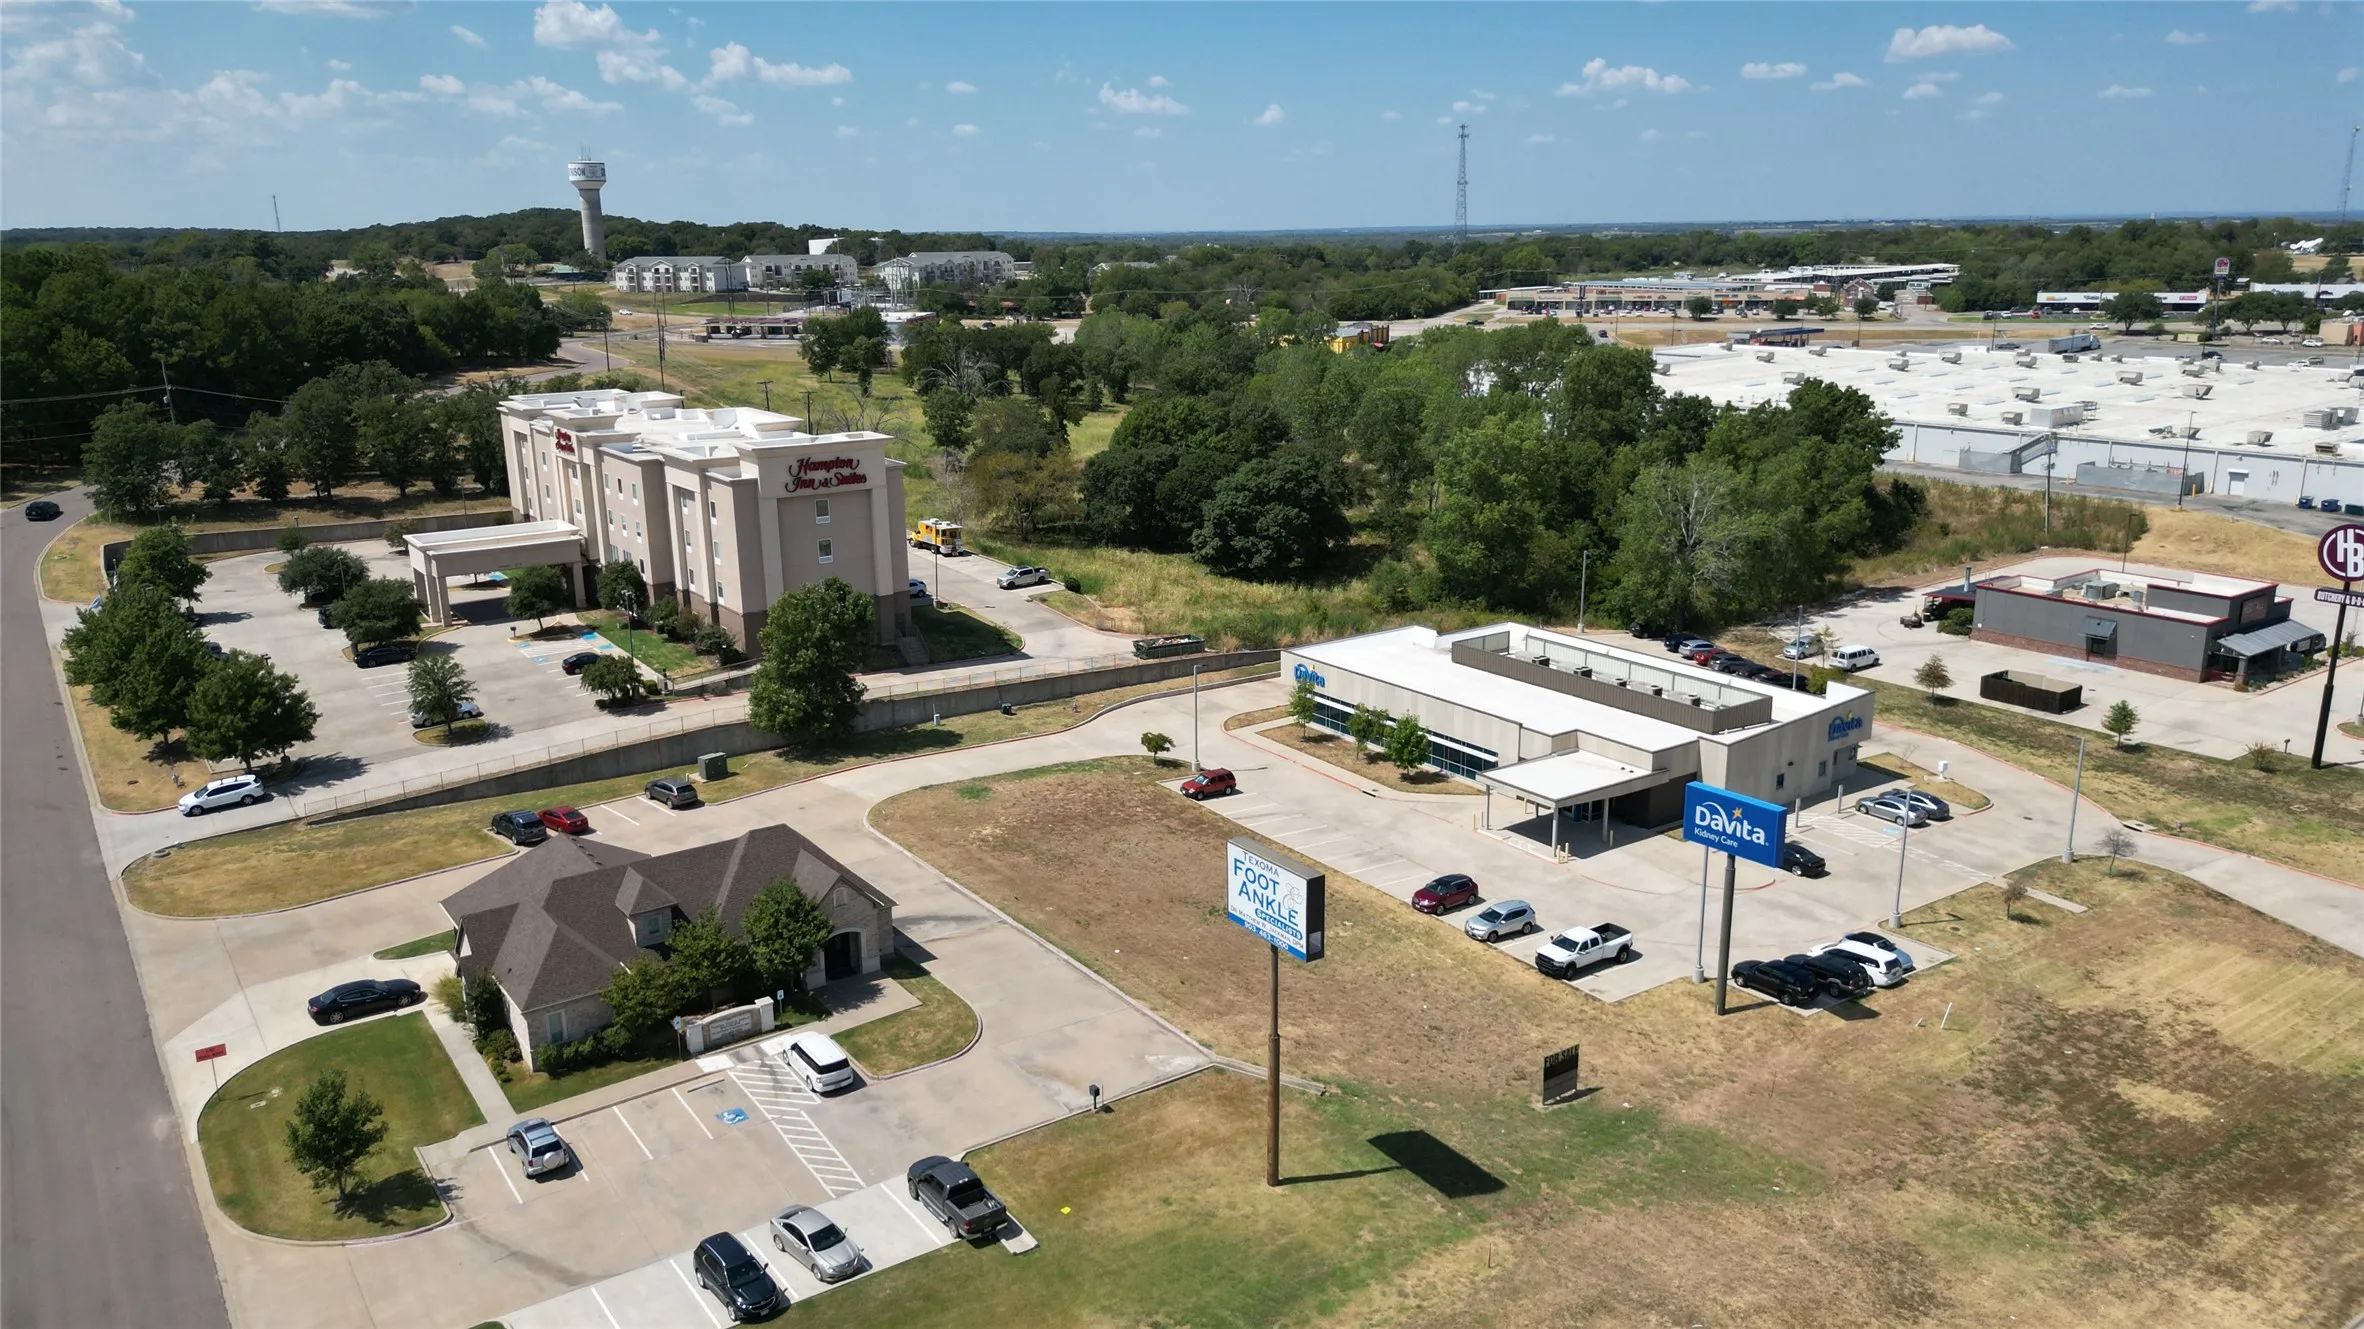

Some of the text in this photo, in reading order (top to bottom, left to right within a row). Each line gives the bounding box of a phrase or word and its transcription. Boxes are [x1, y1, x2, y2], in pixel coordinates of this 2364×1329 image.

[789, 457, 859, 477] Hampton
[785, 476, 820, 493] Inn
[1695, 802, 1765, 846] DaVita
[1695, 827, 1738, 848] Kidney Care
[1234, 858, 1279, 895] FOOT
[1242, 851, 1279, 877] TEXOMA
[1239, 881, 1298, 927] ANKLE
[1256, 909, 1300, 939] SPECIALISTS
[1544, 1052, 1560, 1067] FOR
